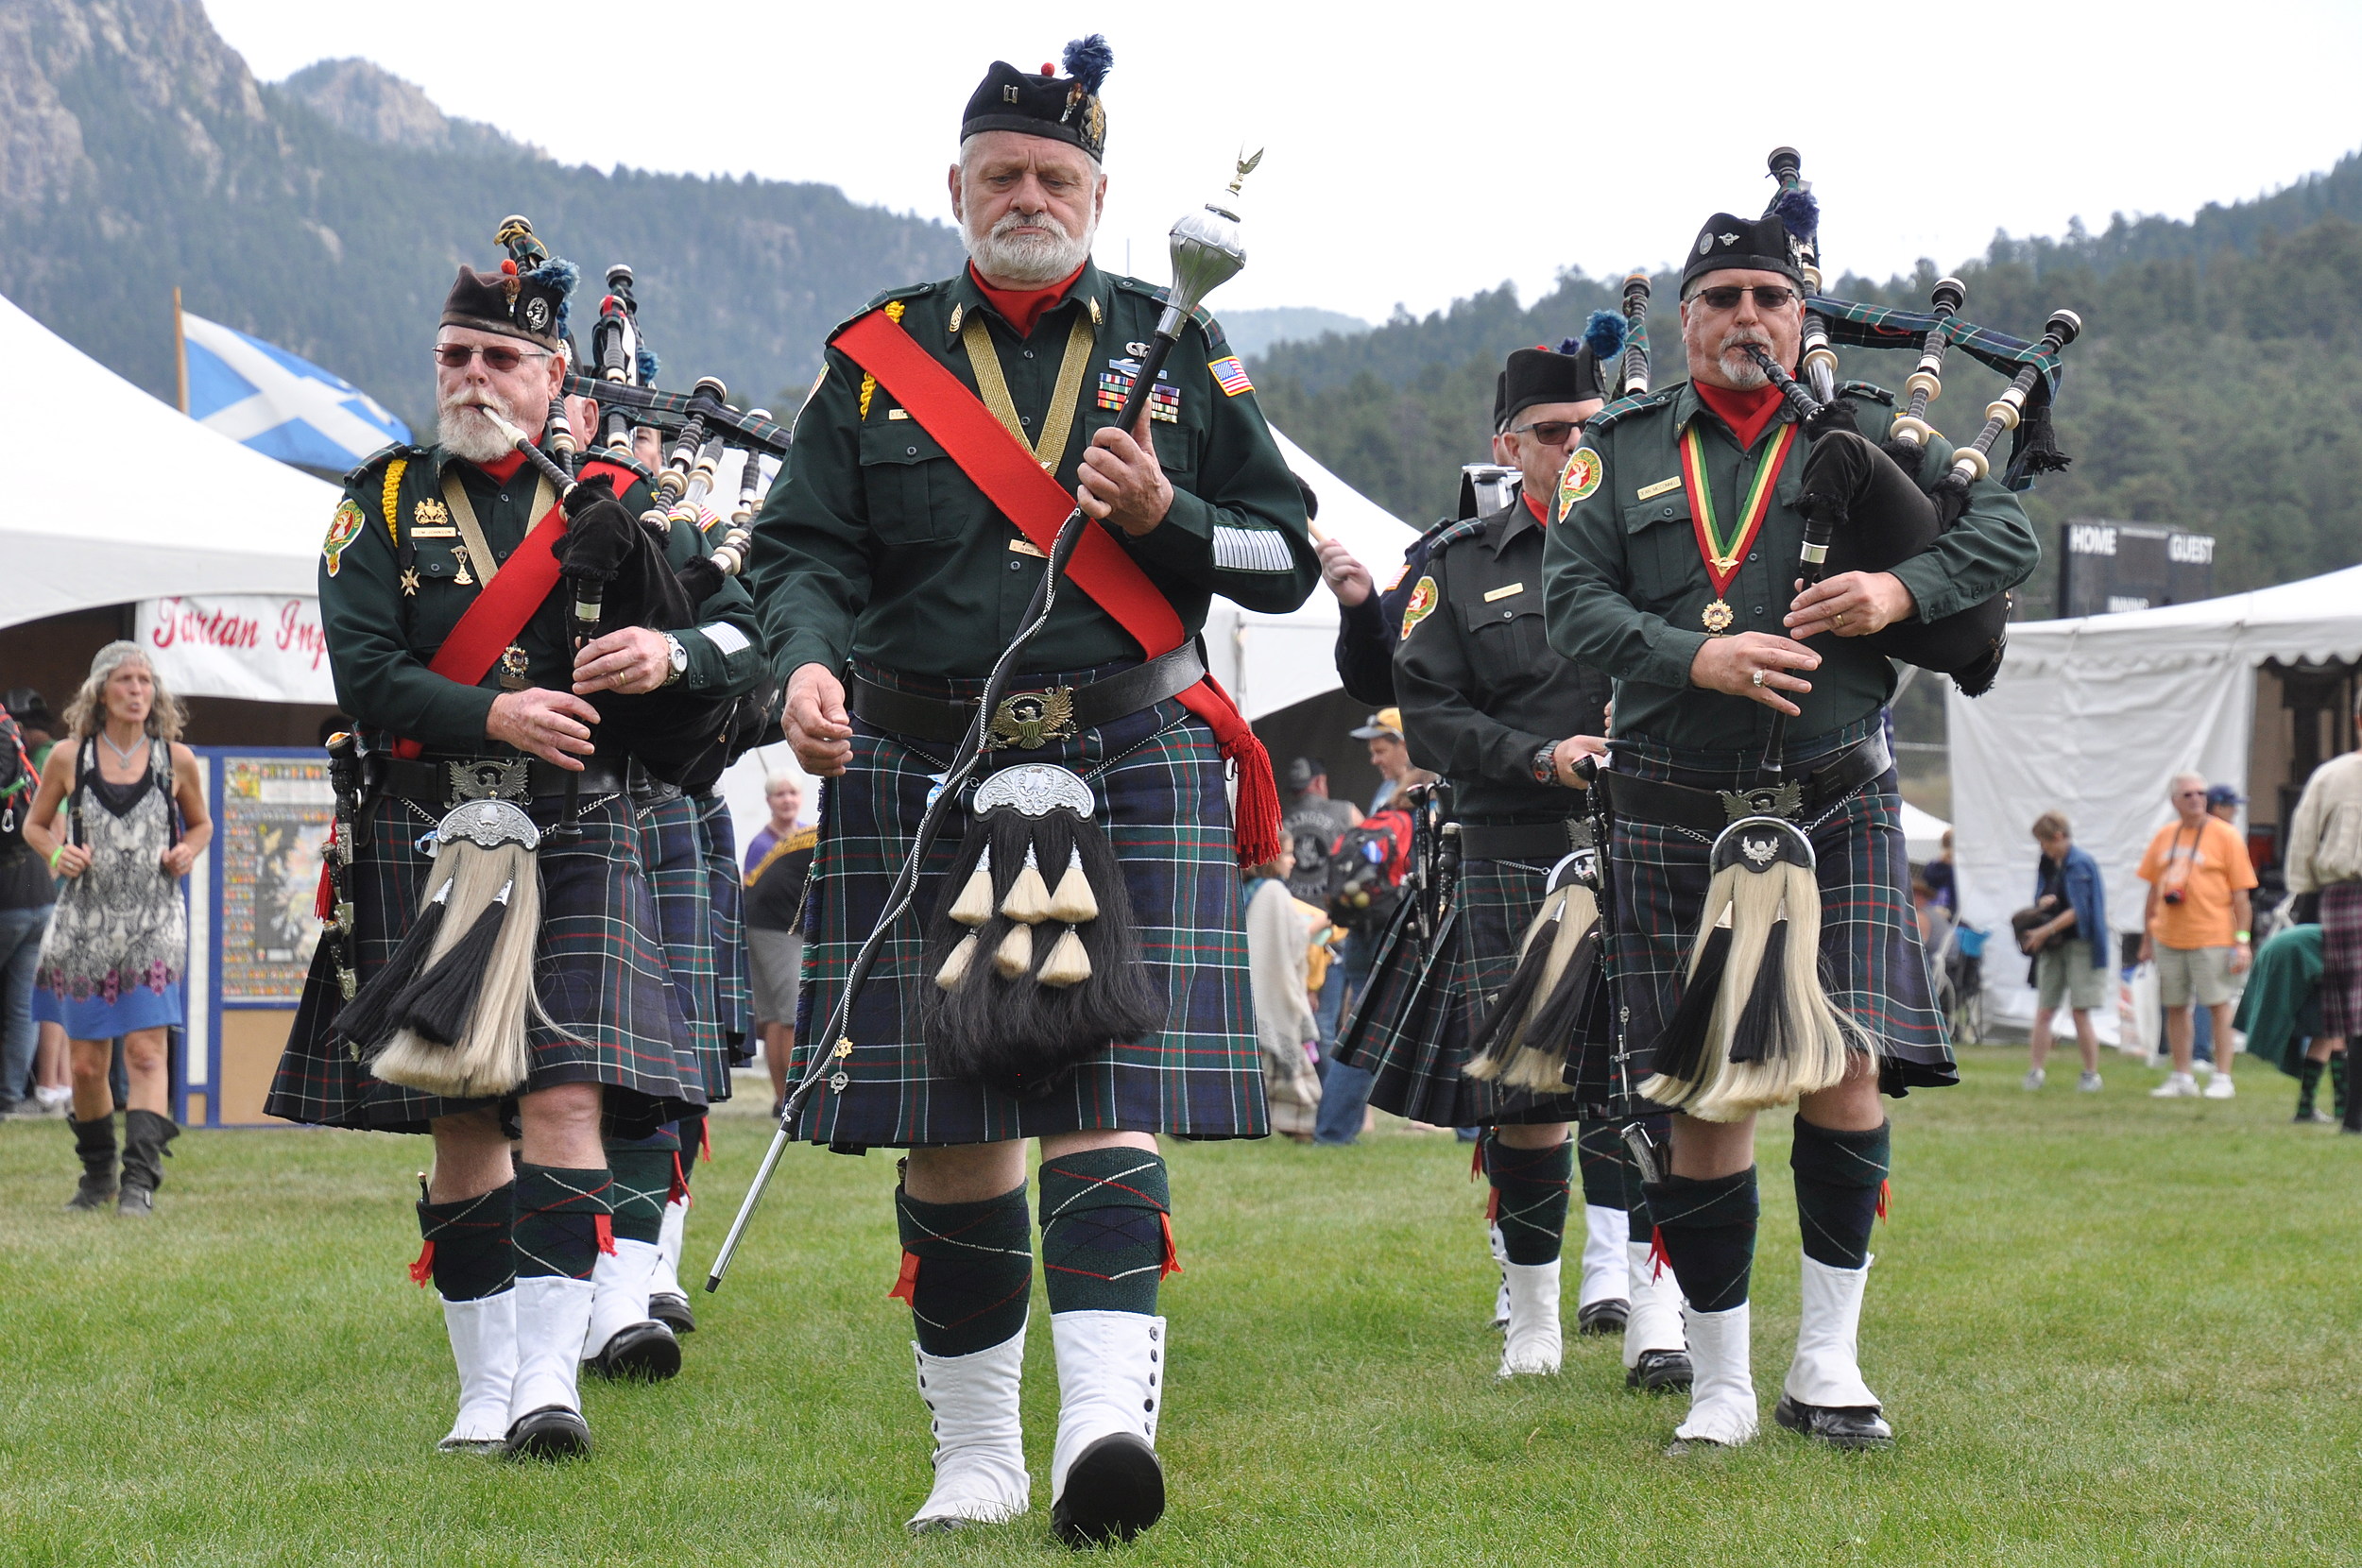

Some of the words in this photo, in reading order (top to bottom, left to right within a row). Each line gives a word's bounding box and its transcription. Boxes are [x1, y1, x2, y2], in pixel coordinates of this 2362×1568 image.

[2070, 524, 2117, 555] HOME
[2168, 534, 2216, 564] GUEST
[153, 596, 260, 648] Tartan
